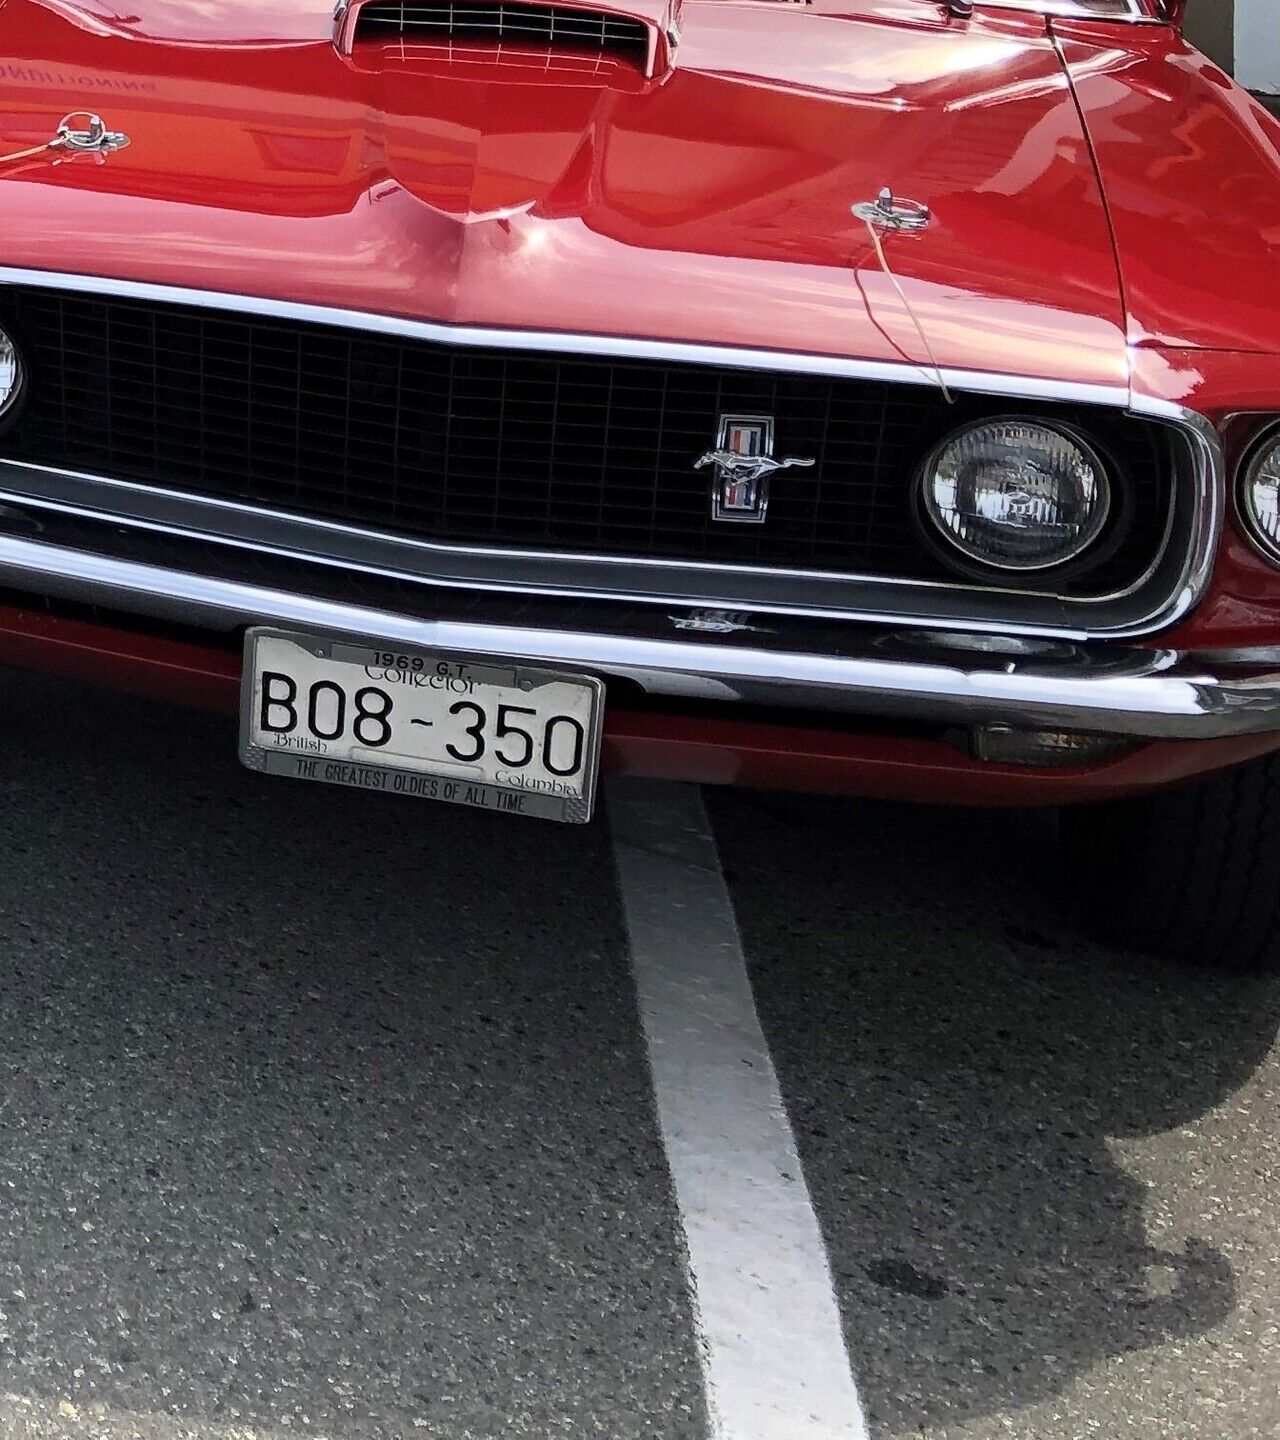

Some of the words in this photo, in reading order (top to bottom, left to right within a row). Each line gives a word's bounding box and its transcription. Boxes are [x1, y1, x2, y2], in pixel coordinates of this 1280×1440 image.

[373, 651, 425, 673] 1969
[260, 670, 585, 777] B08-350
[274, 732, 328, 753] British
[495, 769, 582, 797] Columbia
[297, 760, 319, 778] THE
[325, 765, 389, 789] GREATEST
[393, 775, 438, 797] OLDIES
[443, 784, 460, 800] OF
[464, 787, 488, 806] ALL
[496, 792, 525, 812] TIME
